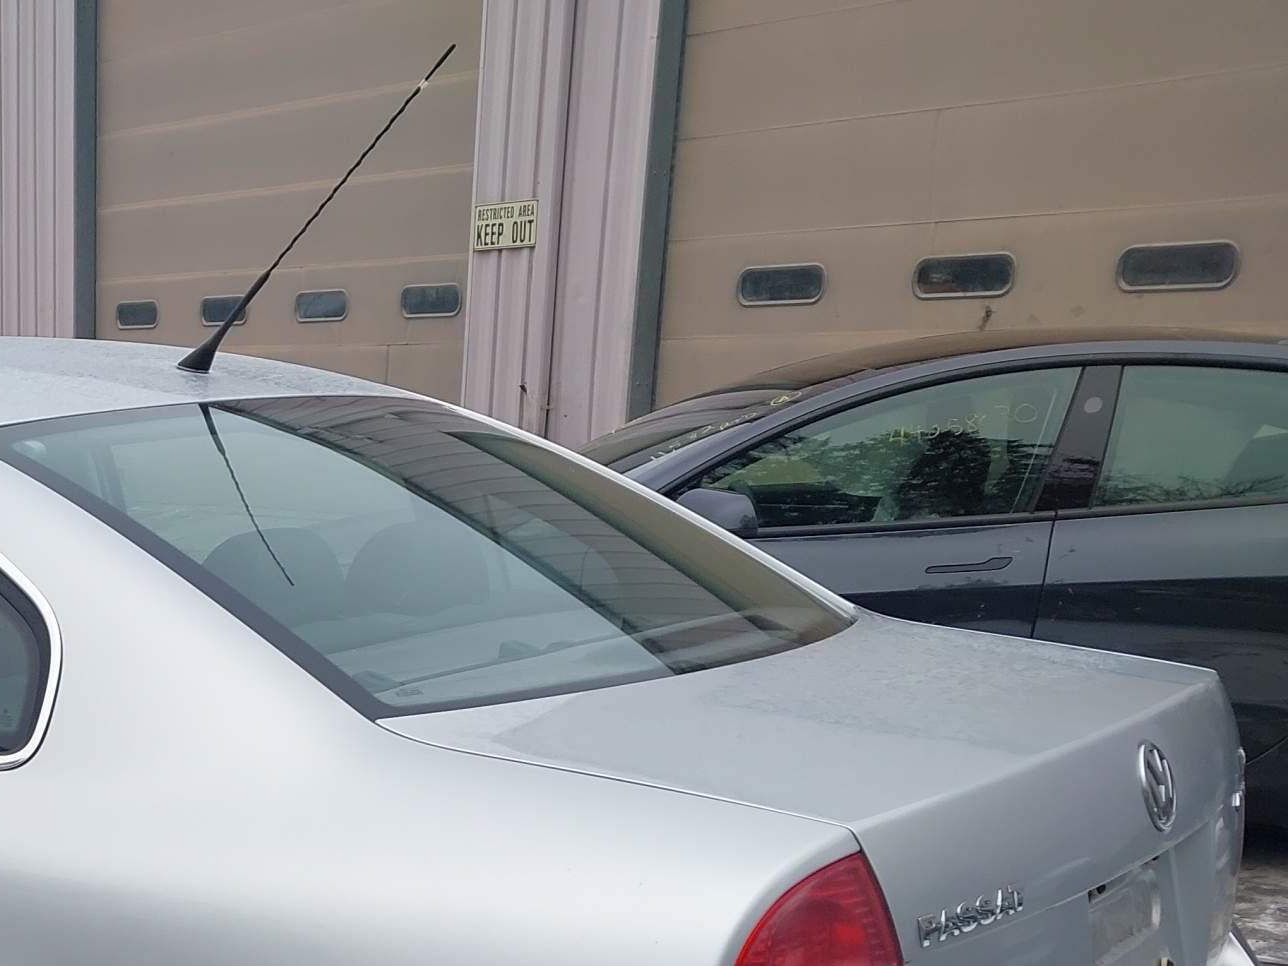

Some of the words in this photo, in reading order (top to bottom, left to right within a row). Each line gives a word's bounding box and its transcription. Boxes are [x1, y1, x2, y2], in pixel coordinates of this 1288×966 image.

[477, 206, 515, 222] RESTRICTED
[518, 204, 535, 218] AREA
[476, 222, 504, 247] KEEP
[511, 219, 535, 244] OUT
[916, 884, 1025, 949] PASSAT
